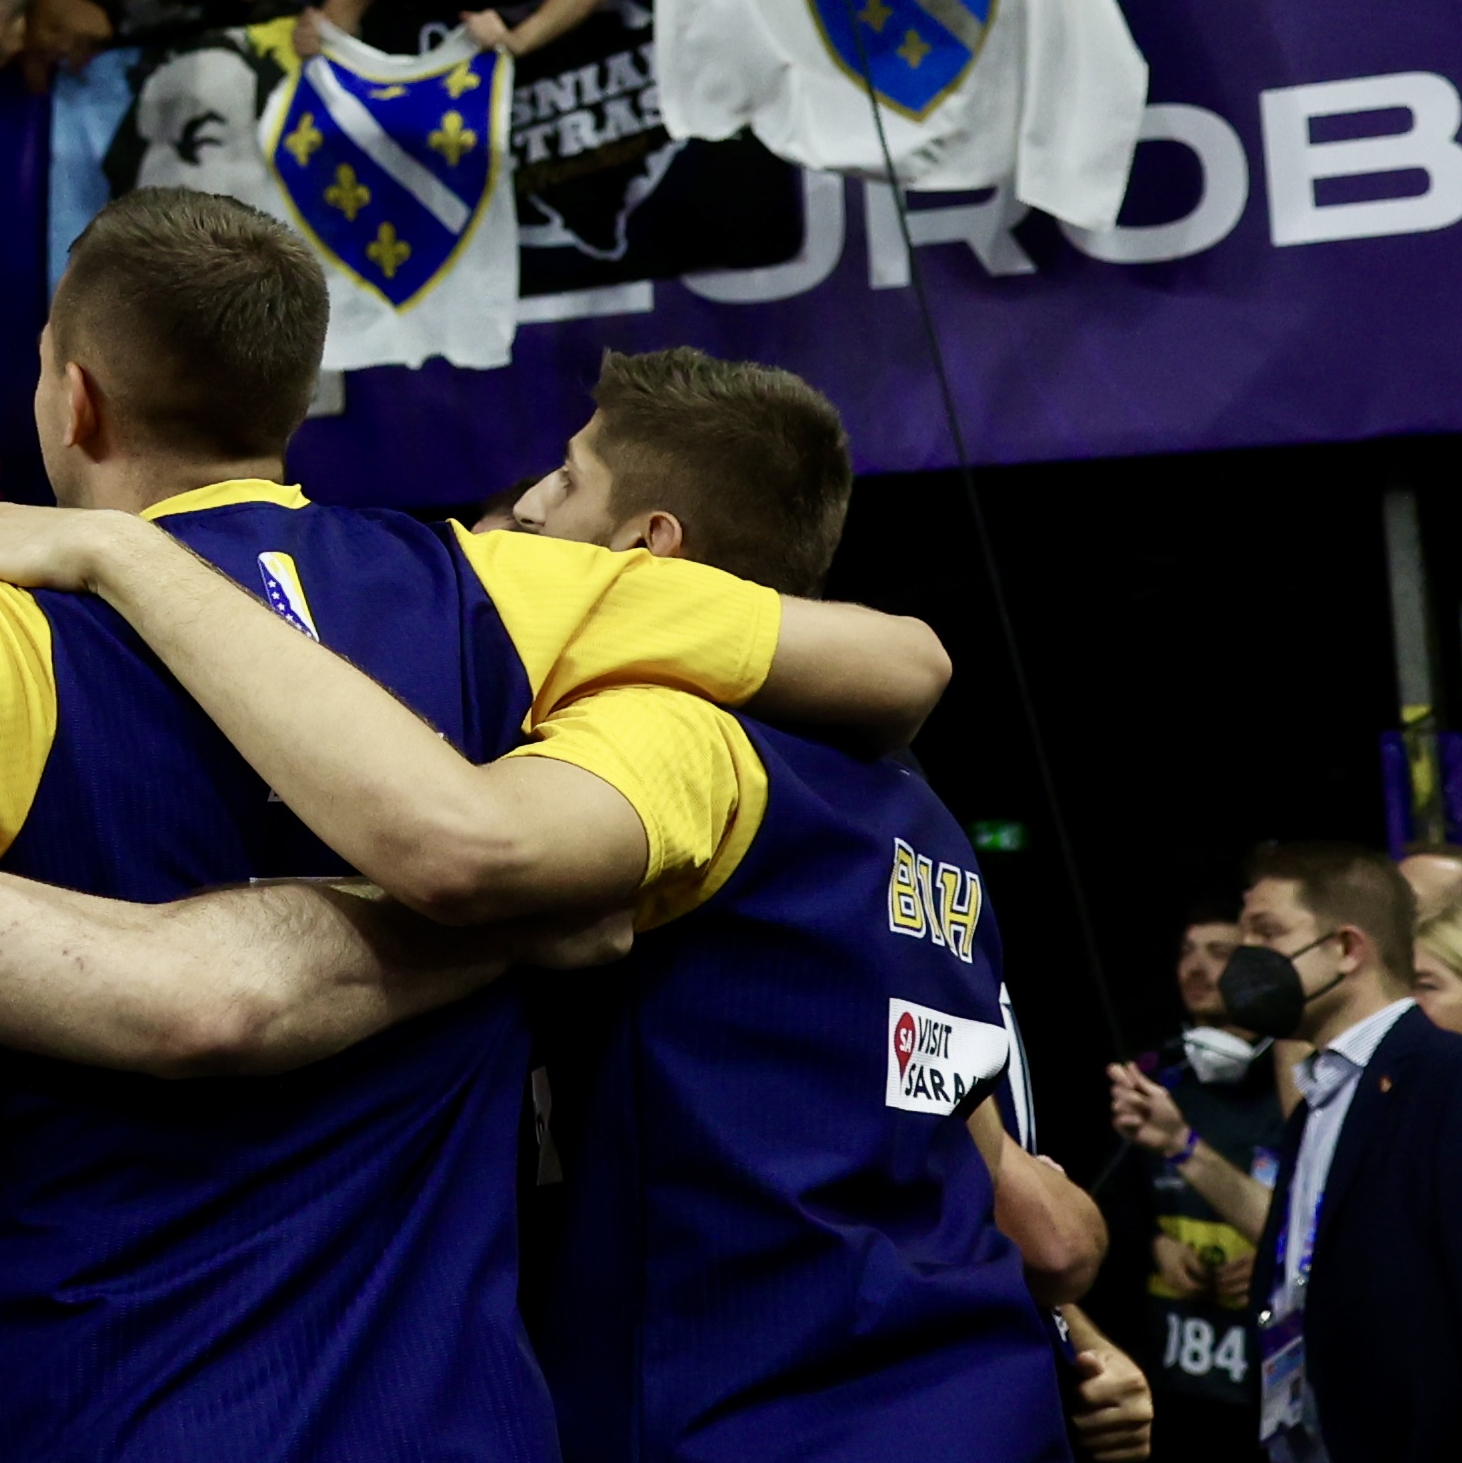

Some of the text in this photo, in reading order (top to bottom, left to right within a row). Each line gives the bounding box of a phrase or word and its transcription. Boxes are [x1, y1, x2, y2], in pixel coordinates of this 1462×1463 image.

[887, 837, 982, 964] BIH
[918, 1015, 953, 1060] VISIT
[904, 1062, 979, 1105] SARA
